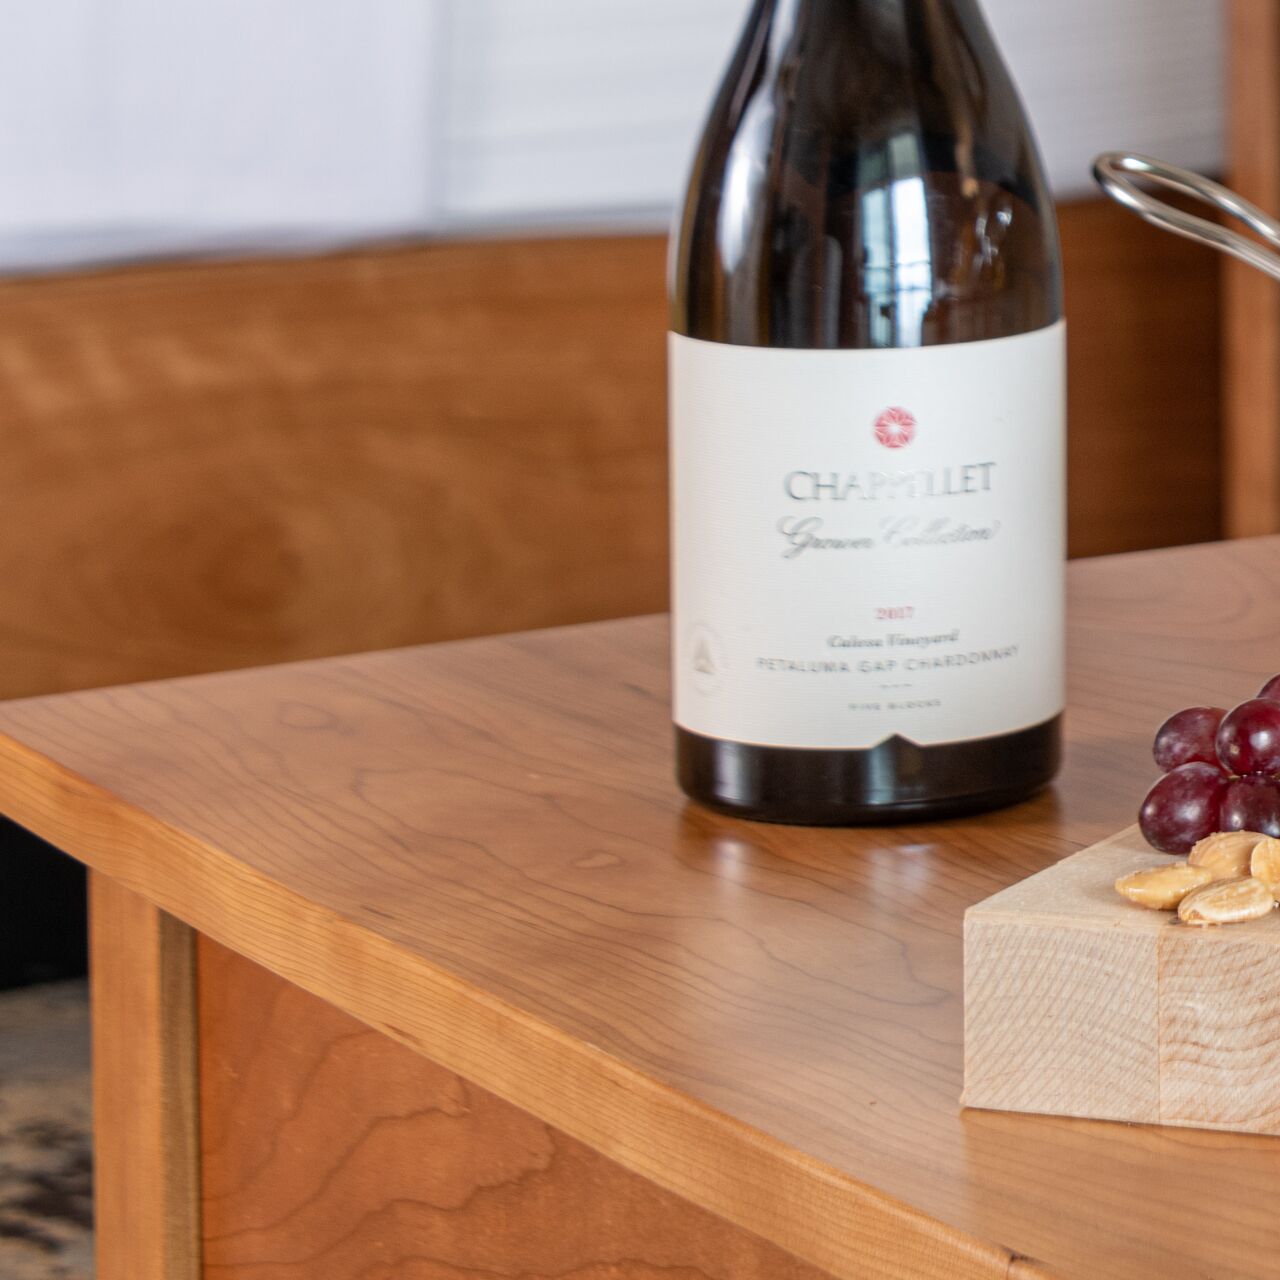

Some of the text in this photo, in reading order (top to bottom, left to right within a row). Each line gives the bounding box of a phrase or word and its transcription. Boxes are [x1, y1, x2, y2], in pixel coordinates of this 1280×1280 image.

[886, 629, 960, 649] Vineyard
[757, 644, 1020, 674] PETALUMA GAP CHARDONNAY
